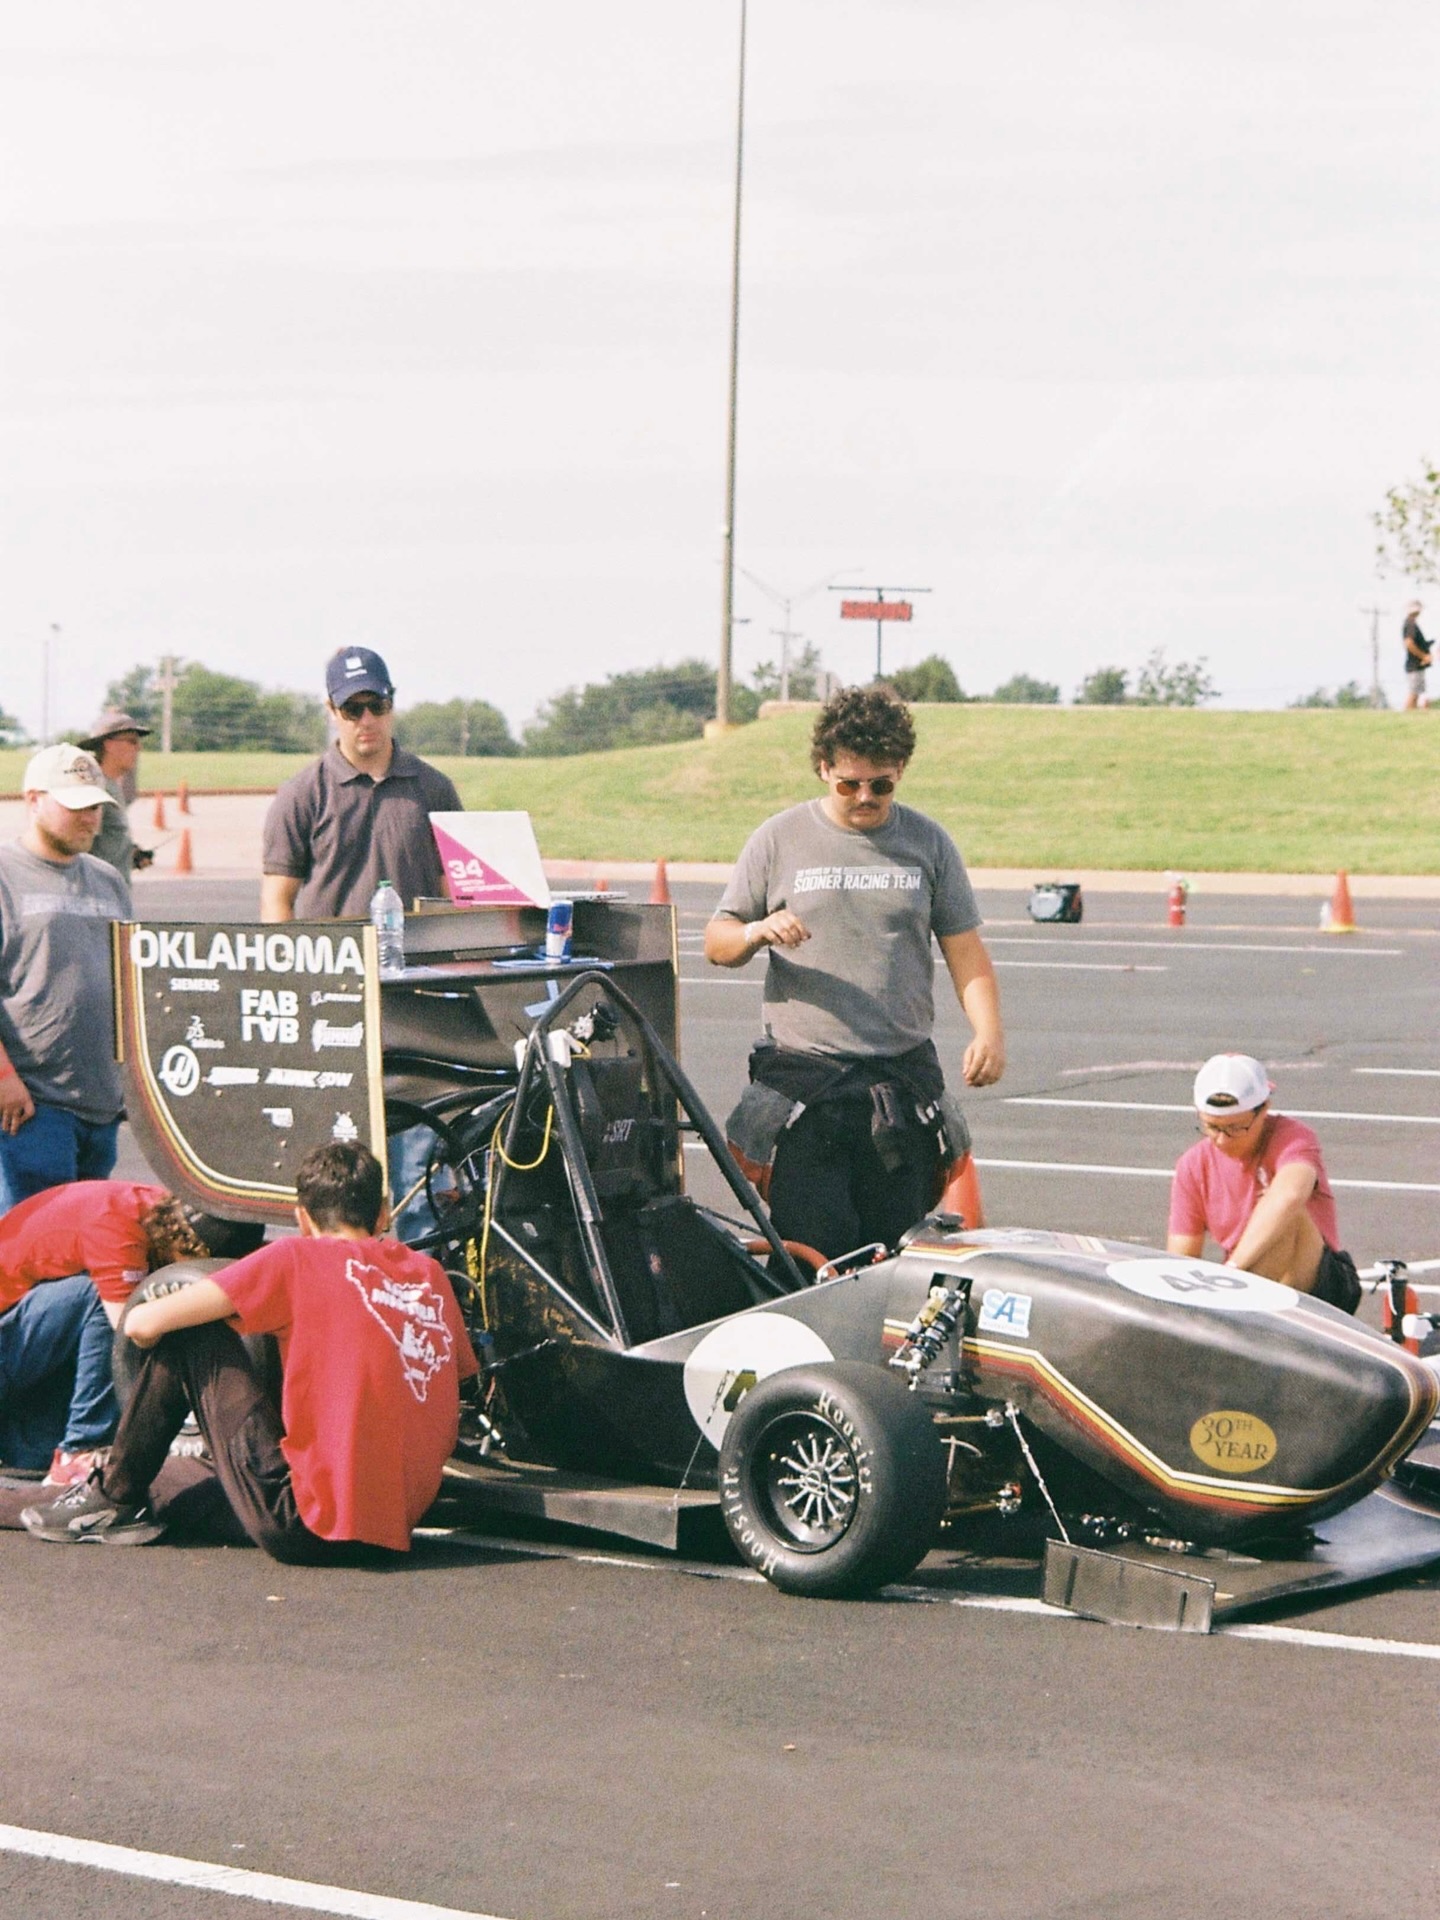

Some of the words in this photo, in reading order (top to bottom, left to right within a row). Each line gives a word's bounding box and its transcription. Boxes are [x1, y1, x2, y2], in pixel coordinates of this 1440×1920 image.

[447, 859, 484, 879] 34
[794, 874, 841, 893] SOONER
[843, 873, 890, 890] RACING
[893, 875, 921, 891] TEAM
[131, 930, 365, 975] OKLAHOMA
[241, 989, 299, 1016] FAB
[983, 1290, 1029, 1325] SAE
[1215, 1441, 1269, 1461] YEAR
